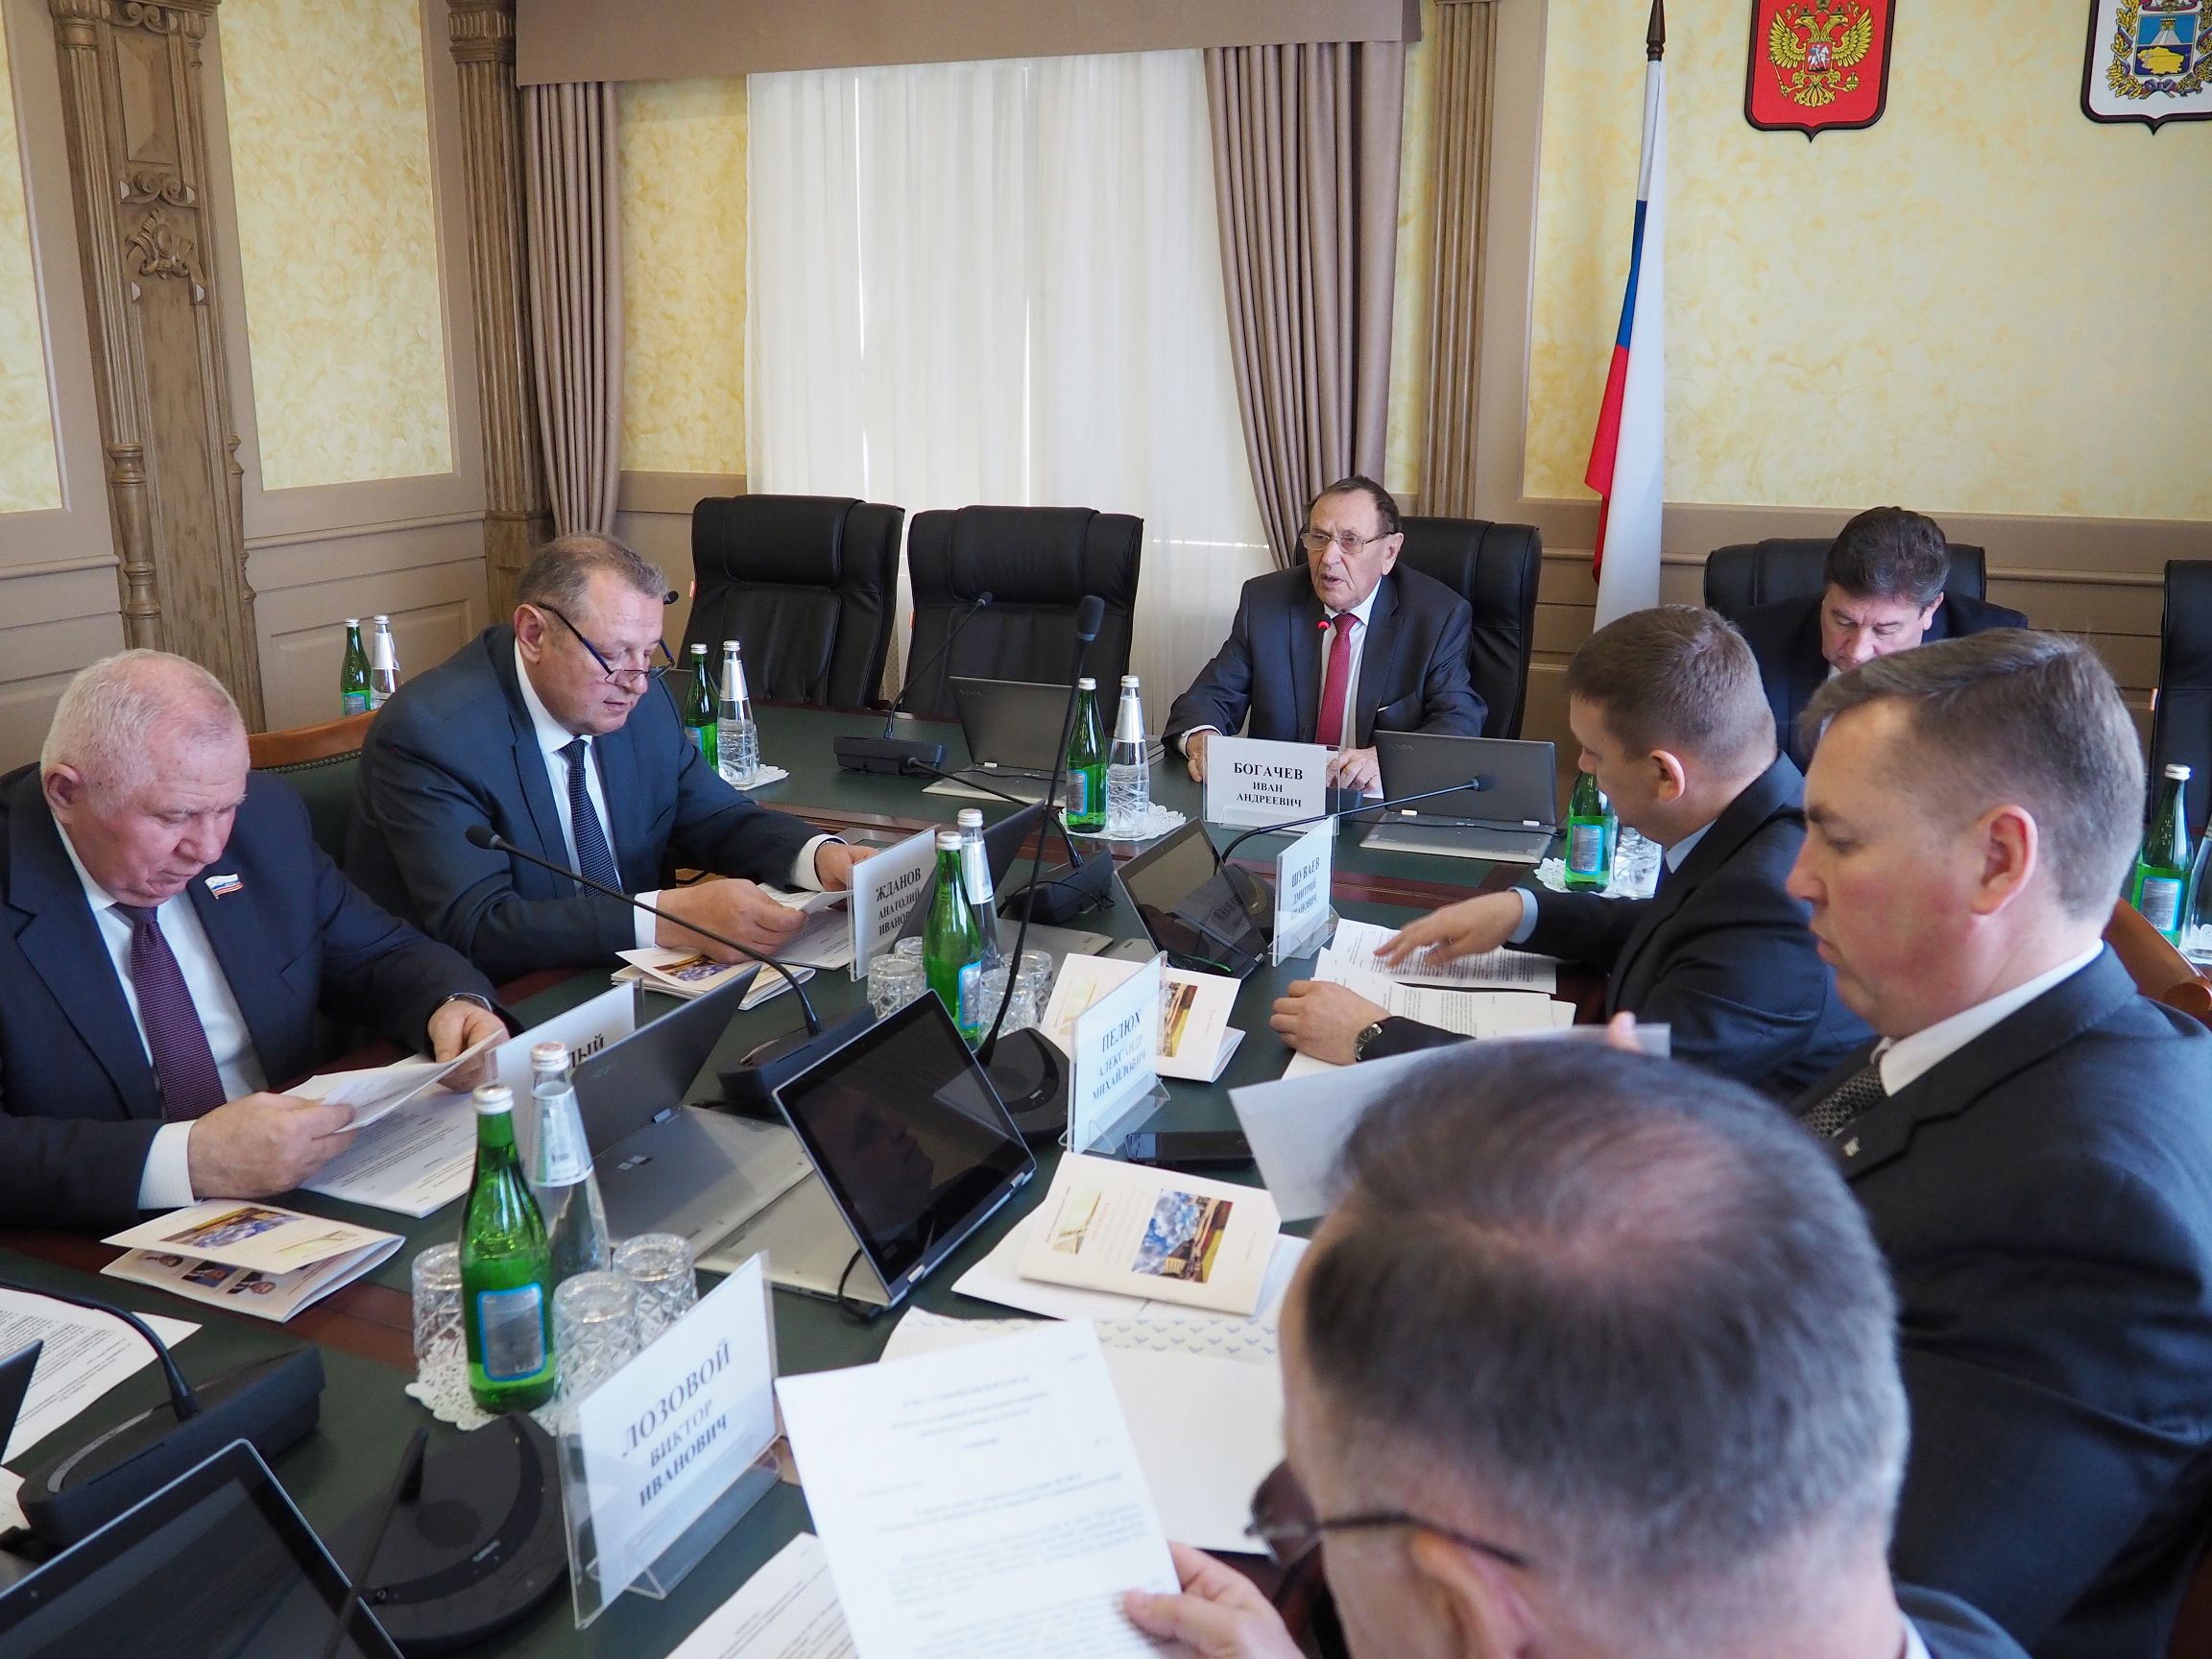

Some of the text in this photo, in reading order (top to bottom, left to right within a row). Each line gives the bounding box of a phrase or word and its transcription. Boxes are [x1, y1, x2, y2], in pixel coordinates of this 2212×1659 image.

[1234, 762, 1303, 780] БОГАЧЕВ
[1253, 781, 1283, 793] ИВАН
[1237, 793, 1302, 807] АНДРЕЕВИЧ
[876, 867, 922, 902] ЖДАНОВ
[1291, 856, 1320, 888] ШУВАЕВ
[878, 888, 922, 921] АНАТОЛИЙ
[878, 911, 913, 936] ИВАНО
[1102, 1008, 1142, 1053] ПЕЛЮХ
[622, 1339, 731, 1457] ЛОЗОВОЙ
[650, 1399, 713, 1468] ВИКТОР
[639, 1413, 728, 1508] ИВАНОВИЧ
